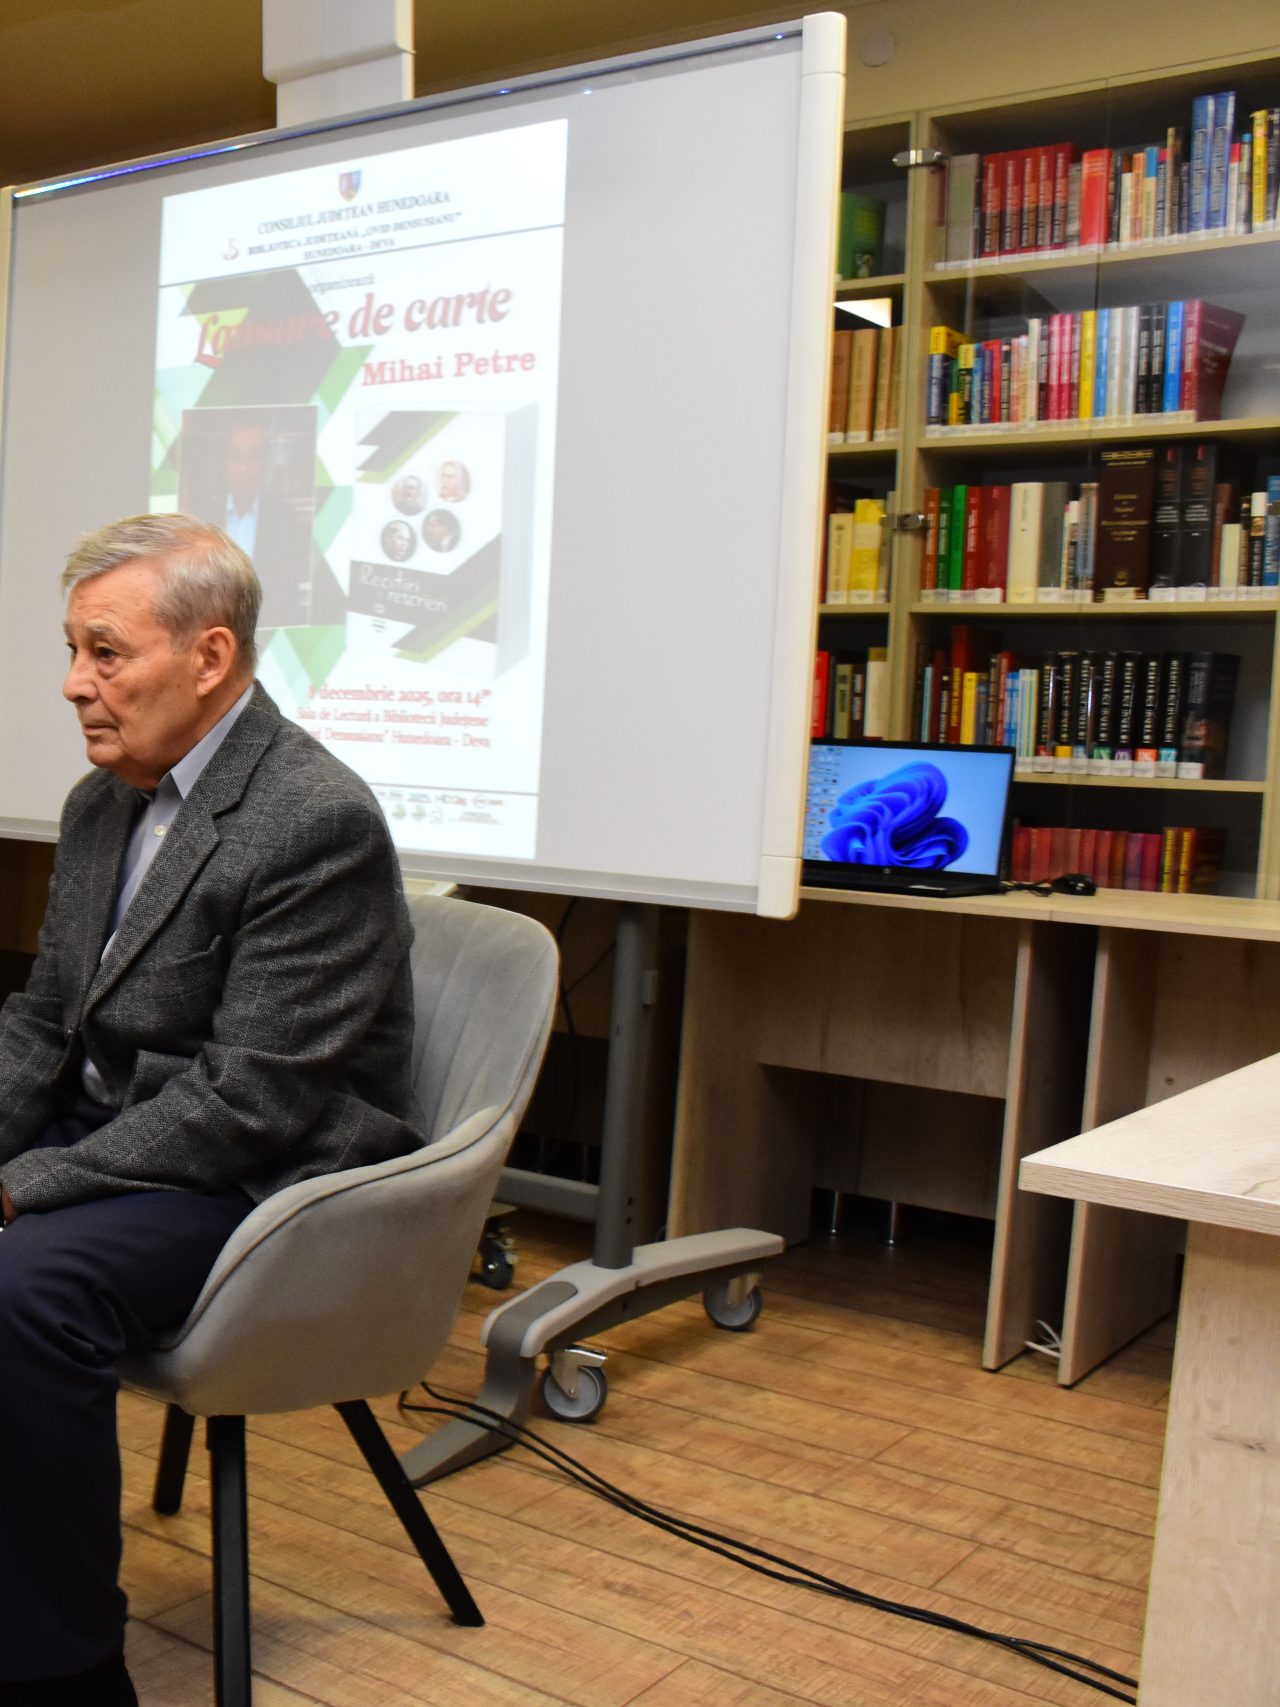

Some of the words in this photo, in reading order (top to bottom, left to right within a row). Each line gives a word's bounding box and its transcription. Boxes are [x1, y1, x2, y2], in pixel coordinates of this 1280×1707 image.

[348, 293, 396, 340] de
[403, 280, 513, 333] carte
[362, 353, 444, 387] Mihai
[453, 348, 536, 378] Petre
[320, 683, 394, 701] decembrie
